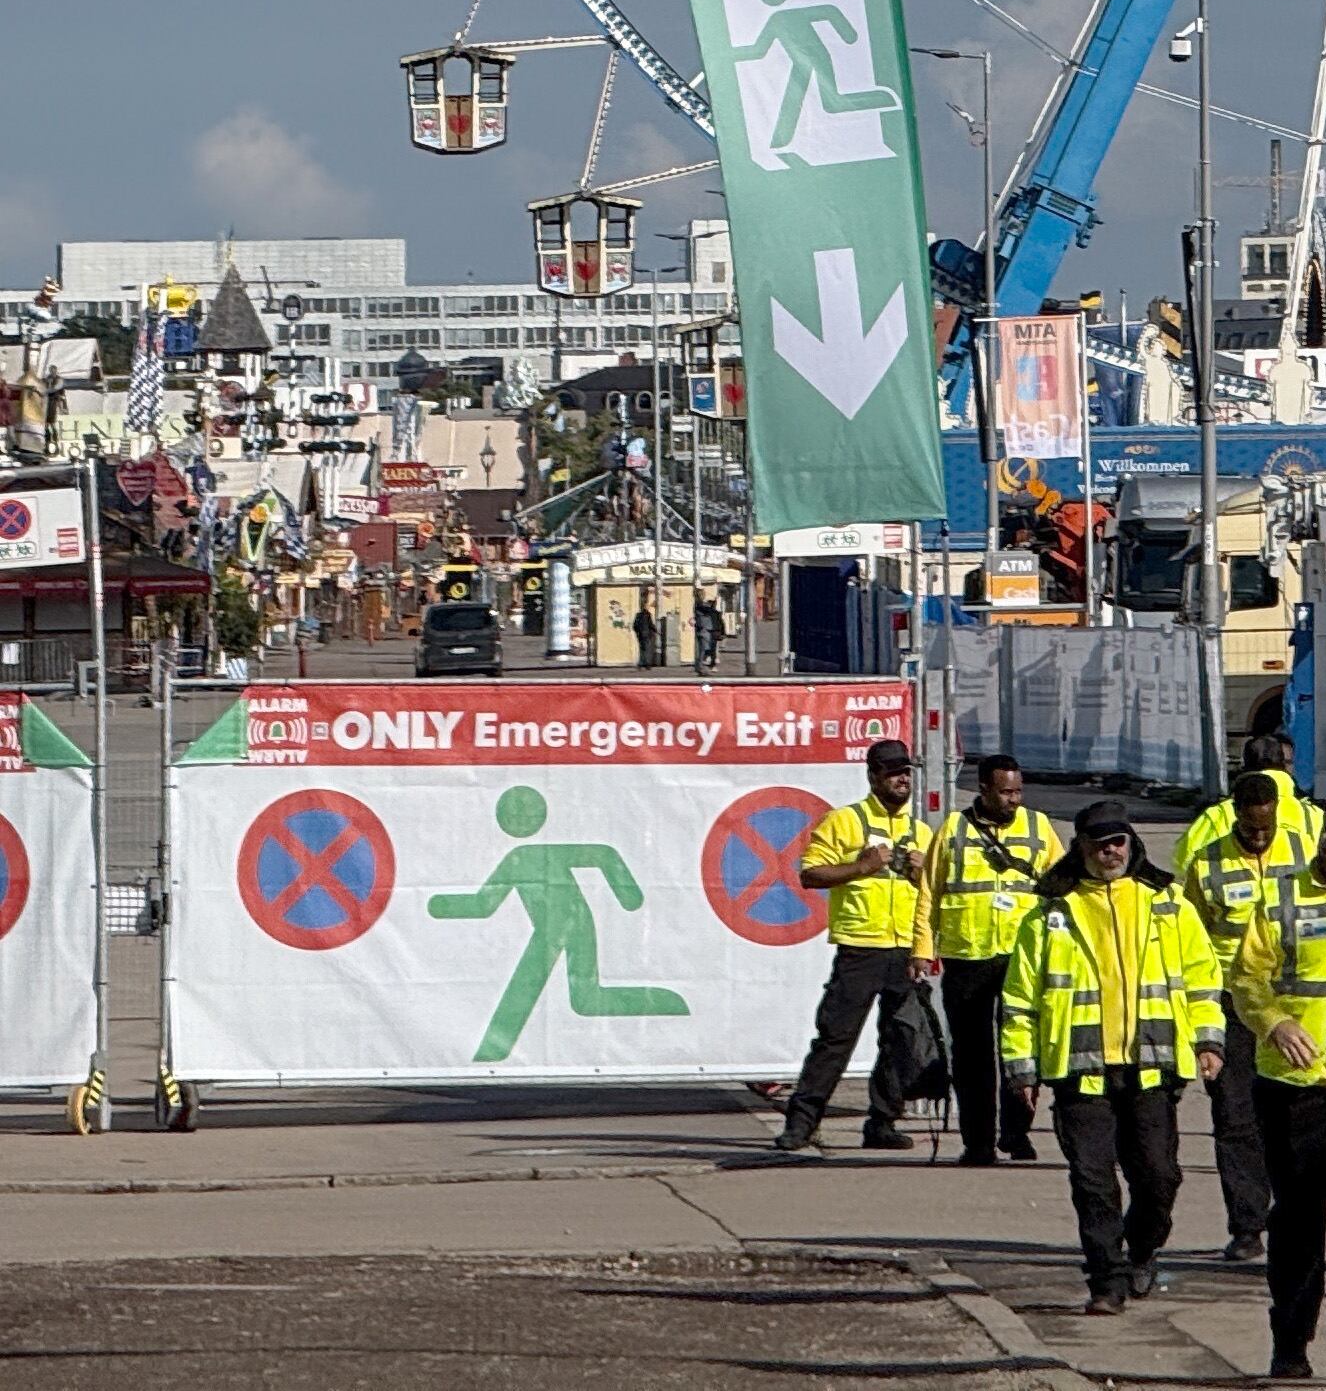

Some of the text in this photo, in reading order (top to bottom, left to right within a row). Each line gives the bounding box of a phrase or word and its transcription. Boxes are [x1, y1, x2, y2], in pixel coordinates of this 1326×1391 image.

[1098, 459, 1190, 472] Willkommen
[998, 560, 1033, 572] ATM
[250, 698, 308, 713] ALARM
[845, 695, 903, 711] ALARM
[332, 710, 815, 757] ONLY Emergency Exit
